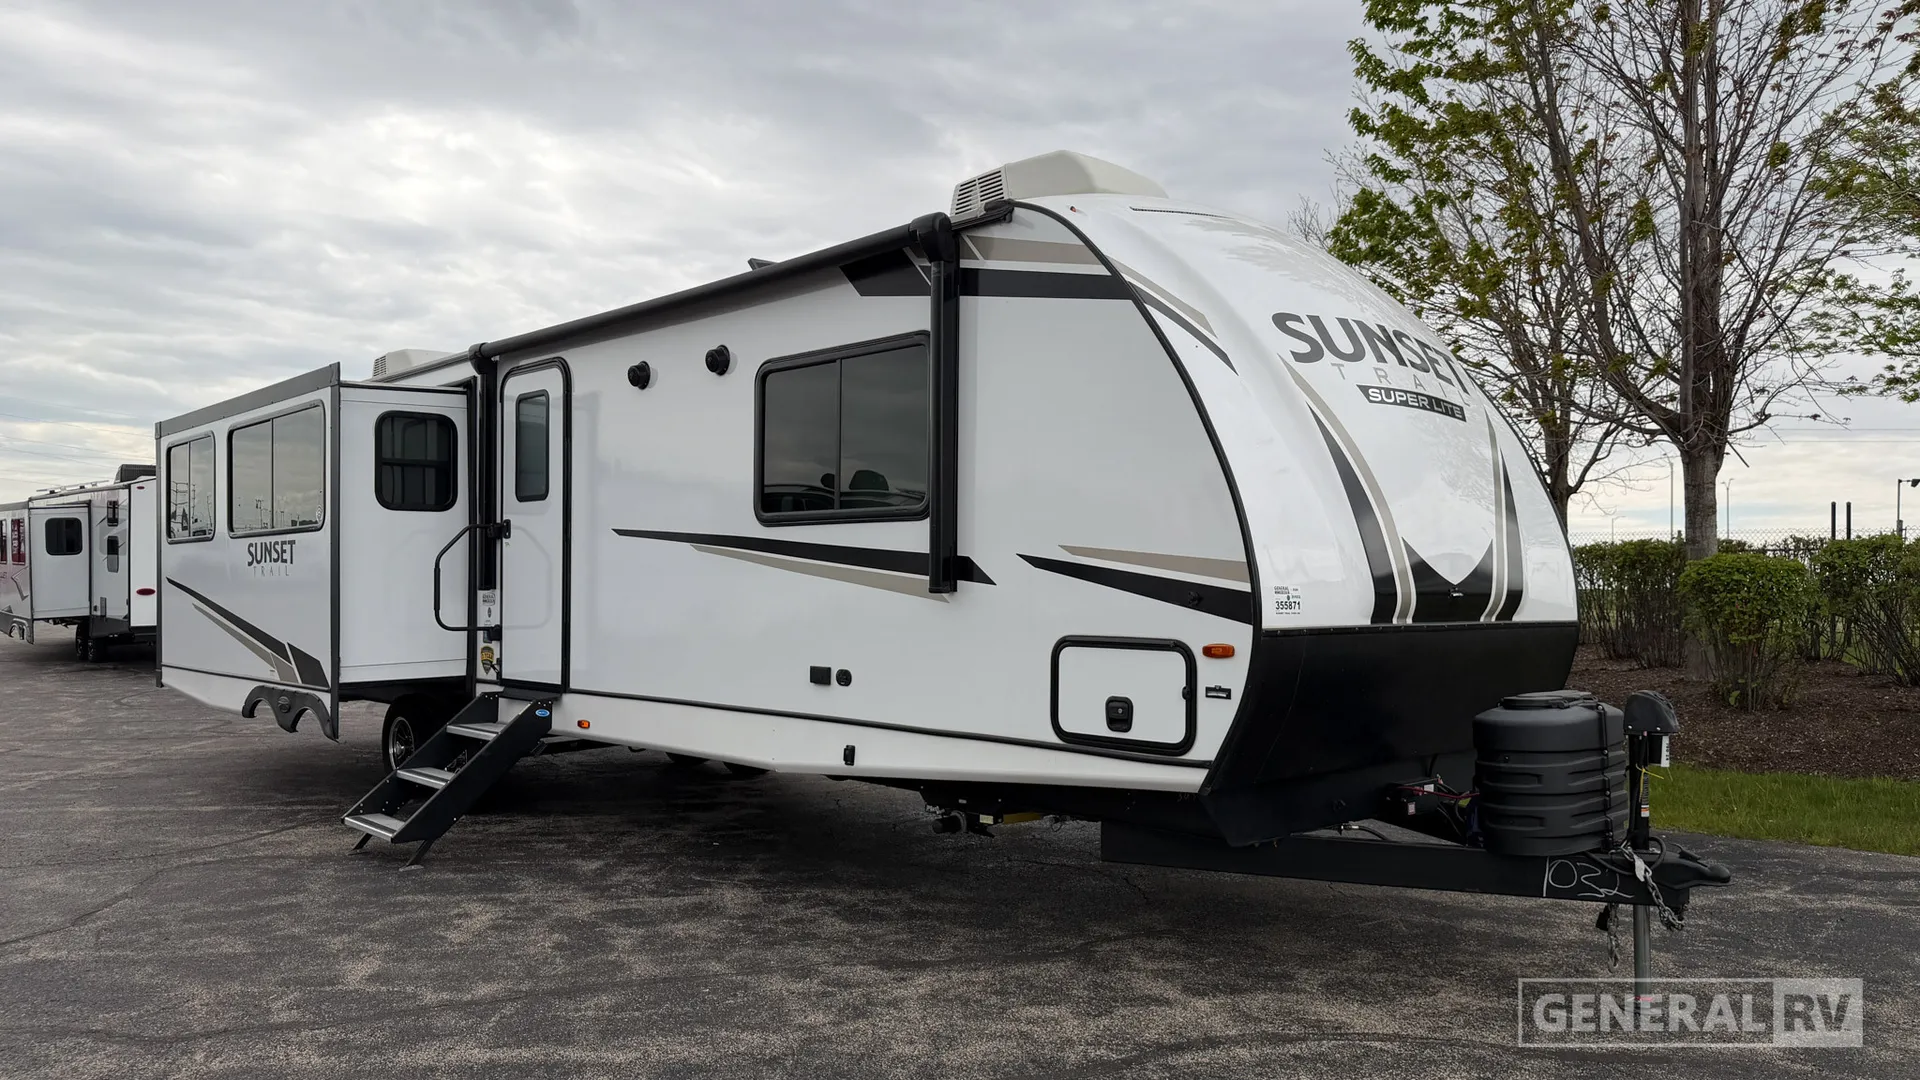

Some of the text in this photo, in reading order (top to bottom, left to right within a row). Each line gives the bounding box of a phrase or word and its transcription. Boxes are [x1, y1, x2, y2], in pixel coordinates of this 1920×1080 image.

[1271, 312, 1471, 397] SUNSET
[1331, 362, 1470, 407] TRAIL
[1368, 388, 1464, 419] SUPER LITE
[247, 540, 296, 567] SUNSET
[253, 565, 290, 578] TRAIL
[1275, 600, 1301, 610] 355871
